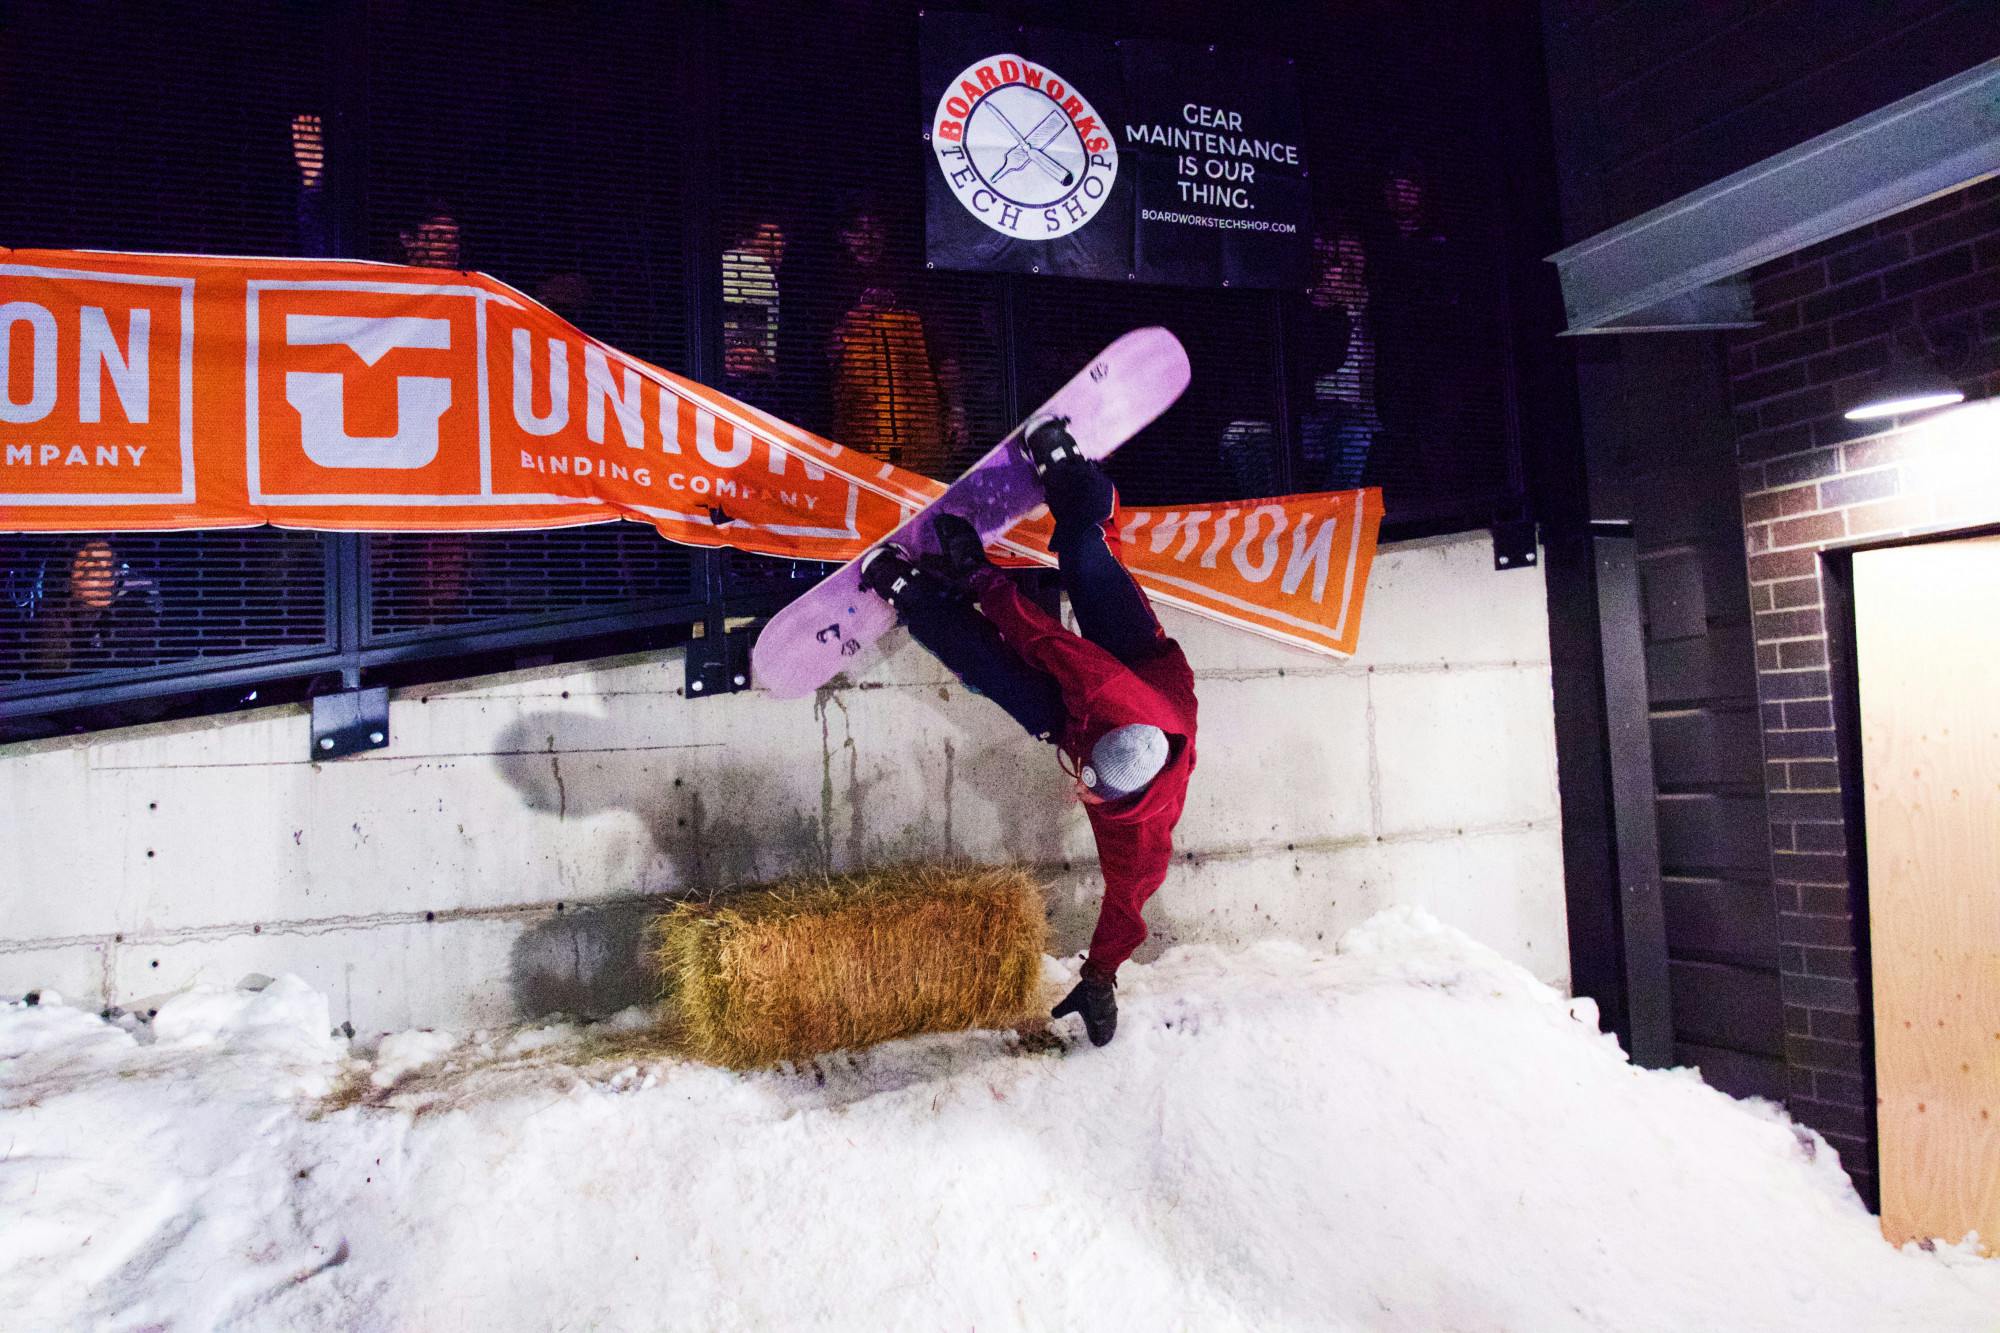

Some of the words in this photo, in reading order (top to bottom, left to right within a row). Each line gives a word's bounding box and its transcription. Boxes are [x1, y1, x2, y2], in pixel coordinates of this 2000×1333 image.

[938, 60, 1109, 154] BOARDWORKS
[1183, 103, 1243, 132] GEAR
[1125, 124, 1299, 165] MAINTENANCE
[1178, 155, 1198, 176] IS
[1205, 159, 1256, 184] OUR
[941, 145, 1023, 231] TECH
[1043, 153, 1113, 232] SHOP
[1177, 181, 1256, 210] THING.
[1141, 209, 1297, 234] BOARDWORKSTECHSHOP.COM
[6, 444, 147, 467] MPANY
[520, 450, 652, 487] BINDING
